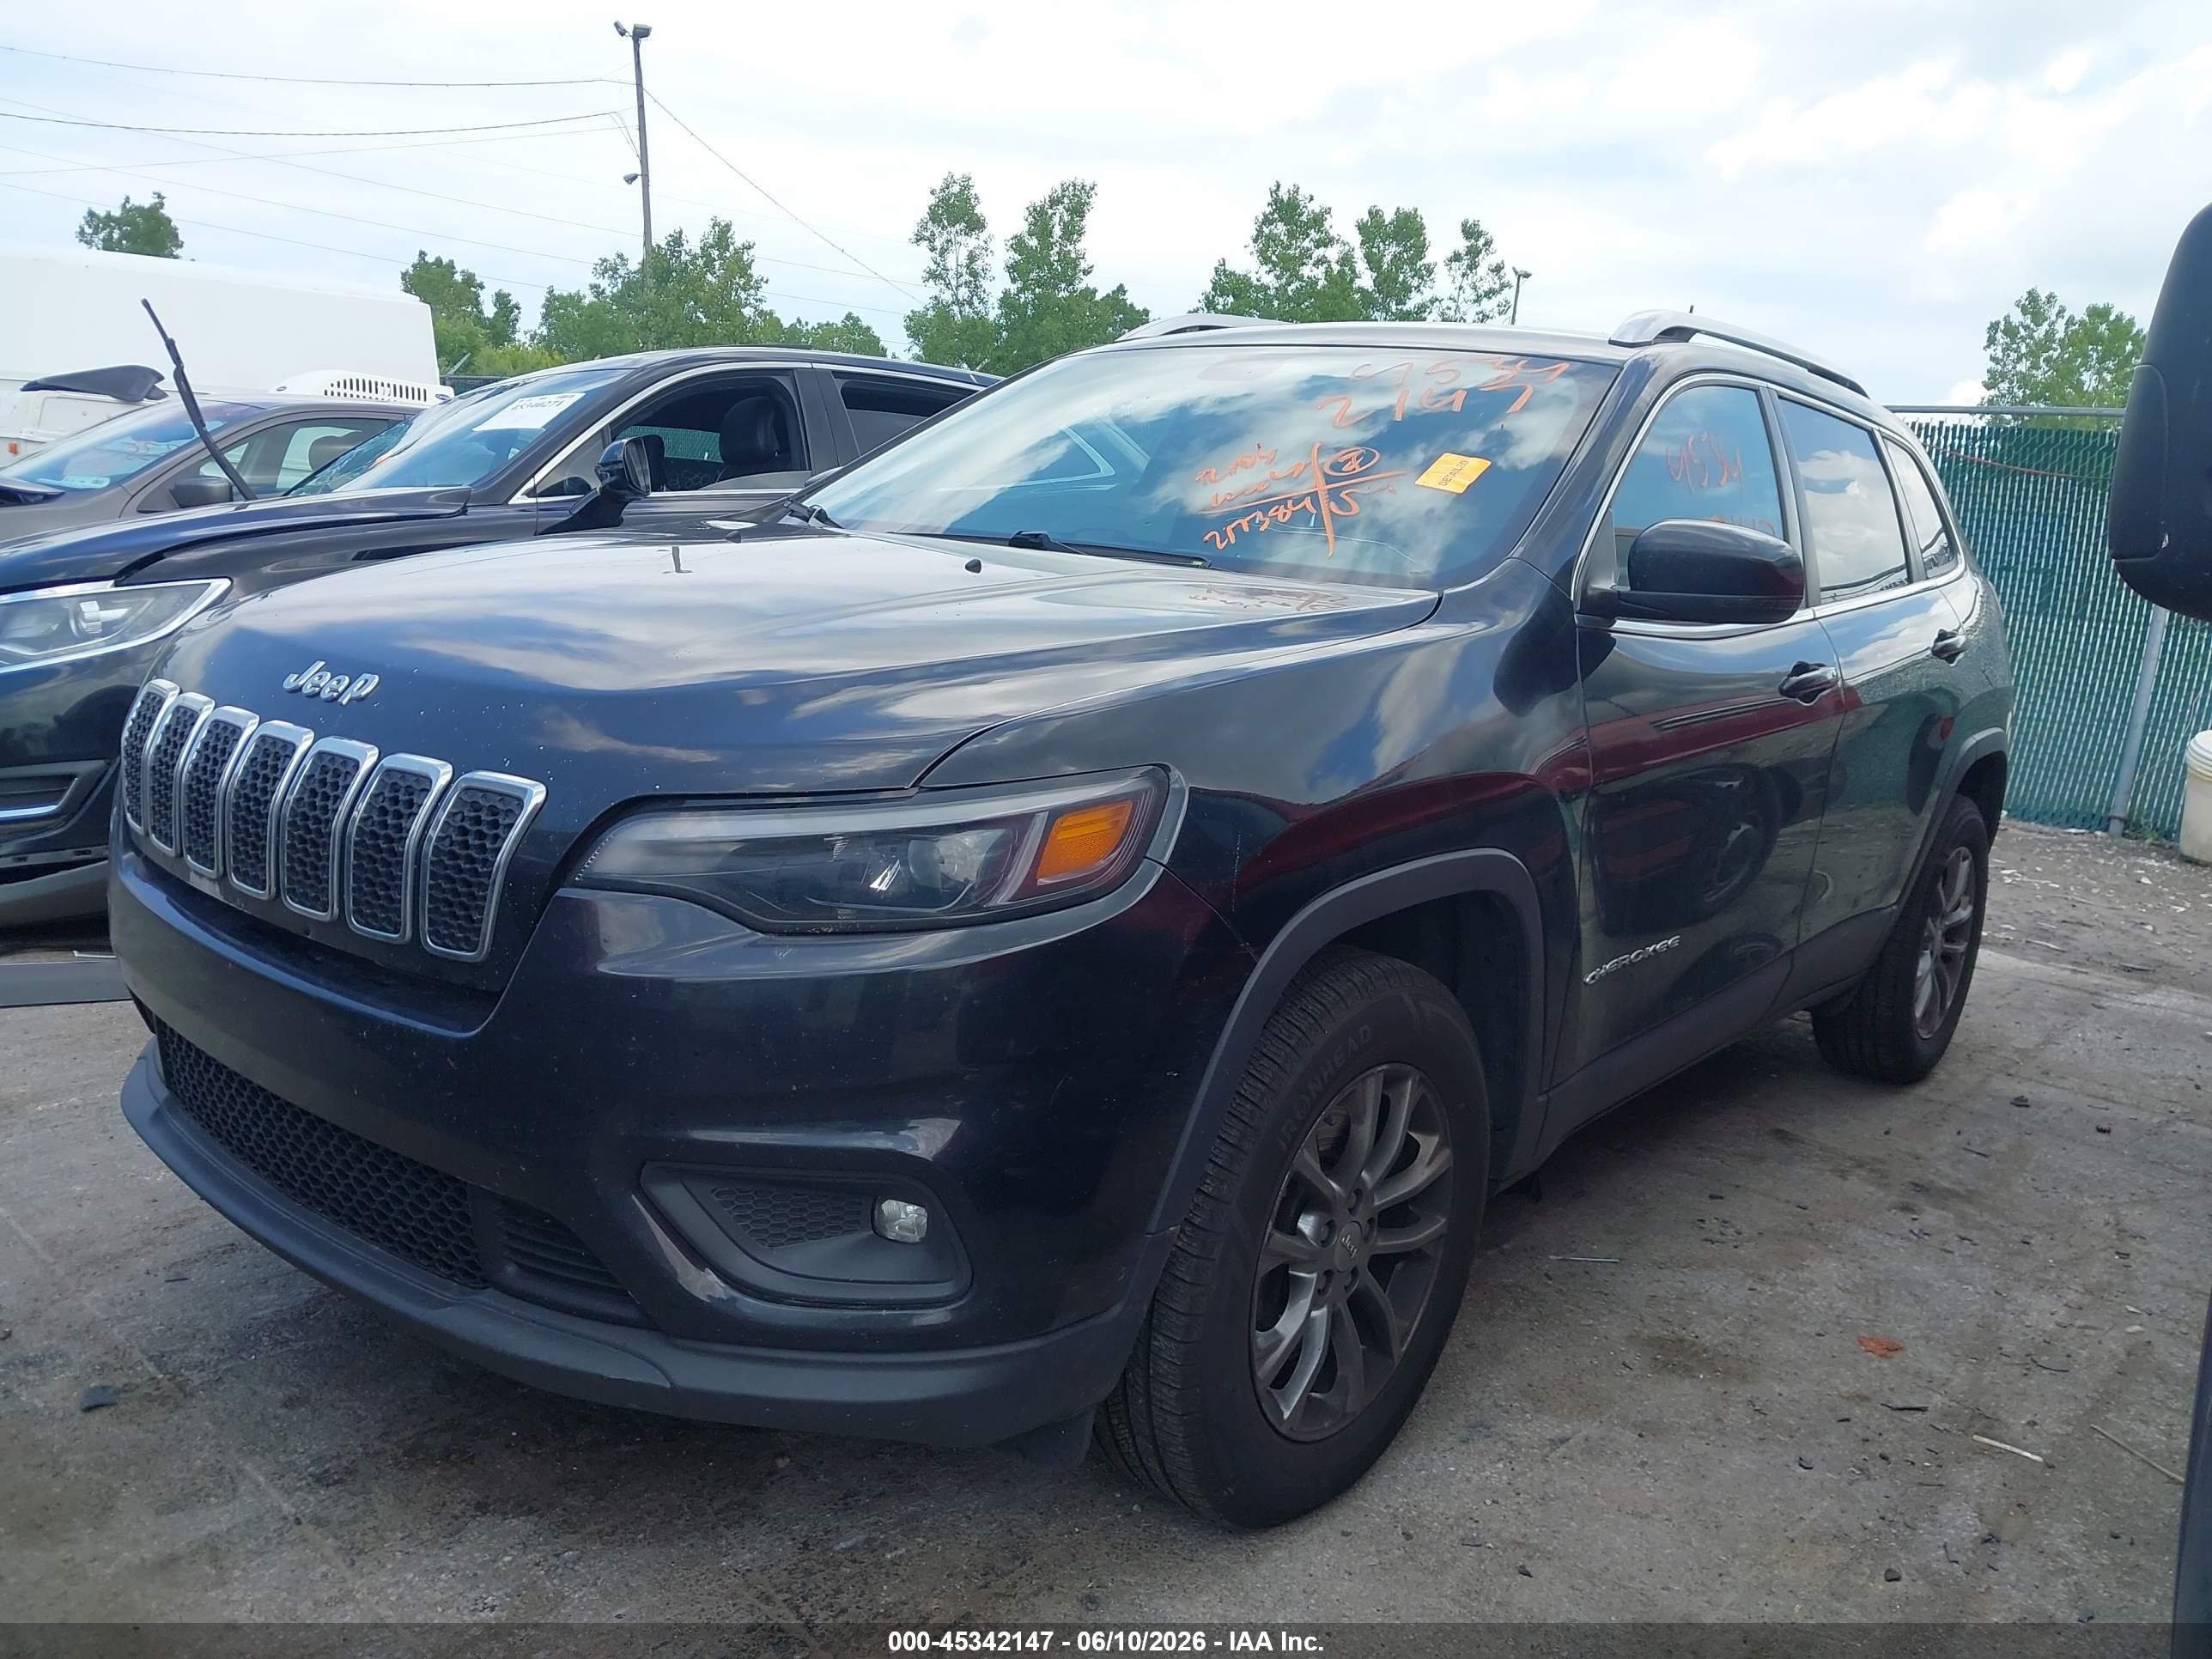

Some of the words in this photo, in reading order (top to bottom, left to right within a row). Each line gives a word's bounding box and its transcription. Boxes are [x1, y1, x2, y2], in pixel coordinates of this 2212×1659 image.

[1437, 460, 1469, 487] DETAILED
[283, 660, 380, 706] Jeep
[1583, 934, 1681, 985] CHEROKEE
